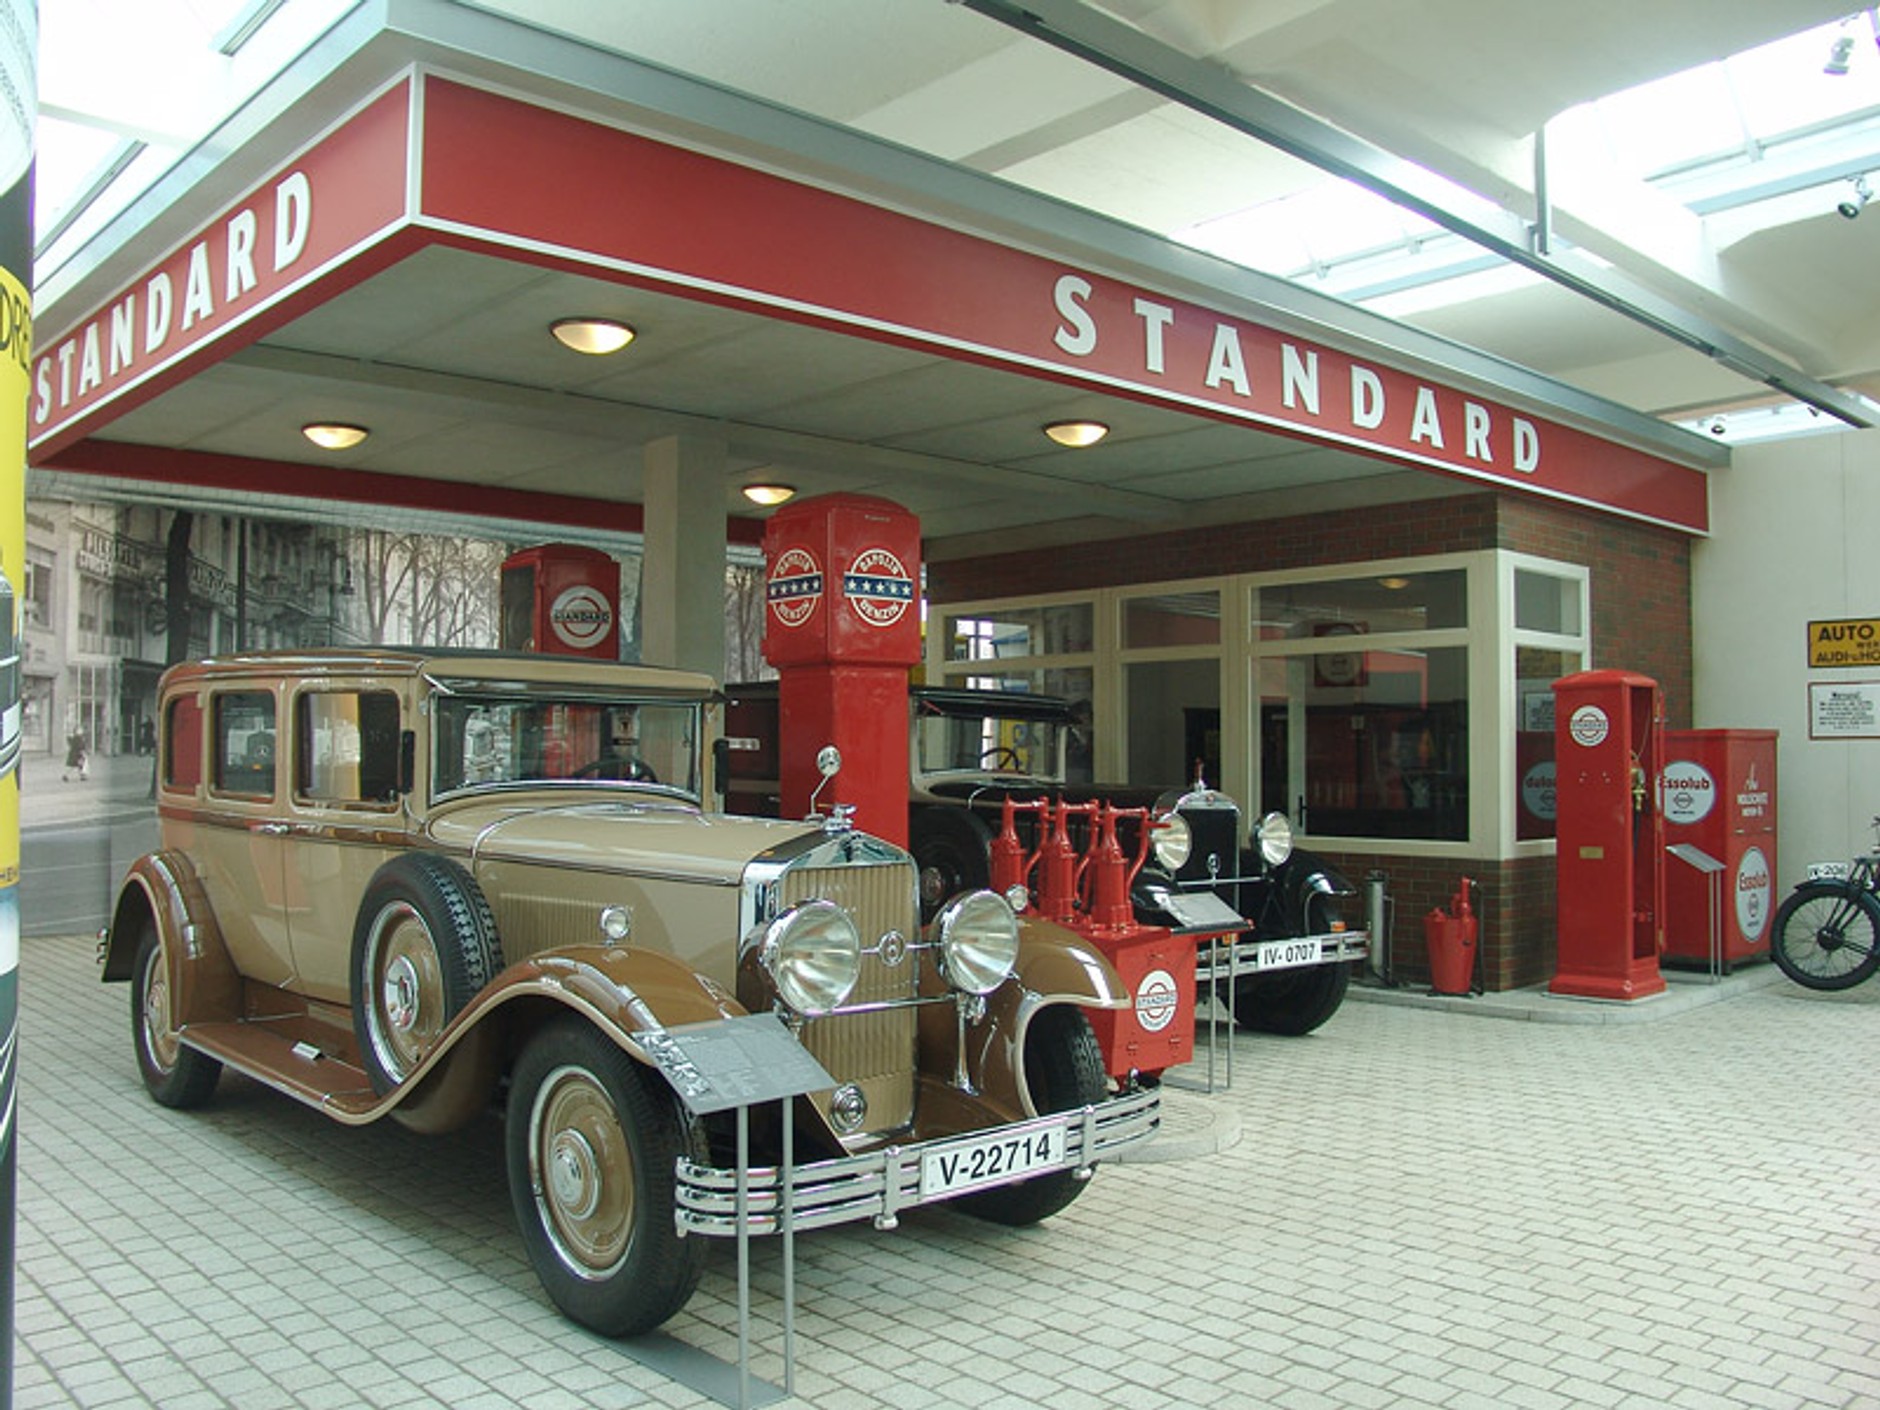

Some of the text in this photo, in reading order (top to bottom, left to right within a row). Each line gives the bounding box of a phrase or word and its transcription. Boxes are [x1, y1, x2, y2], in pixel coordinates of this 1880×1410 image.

[35, 171, 311, 424] STANDARD
[1053, 274, 1541, 474] STANDARD
[860, 599, 899, 619] BENZIN
[1818, 623, 1875, 642] AUTO
[1739, 871, 1767, 892] Essolub
[940, 1132, 1050, 1185] V-22714
